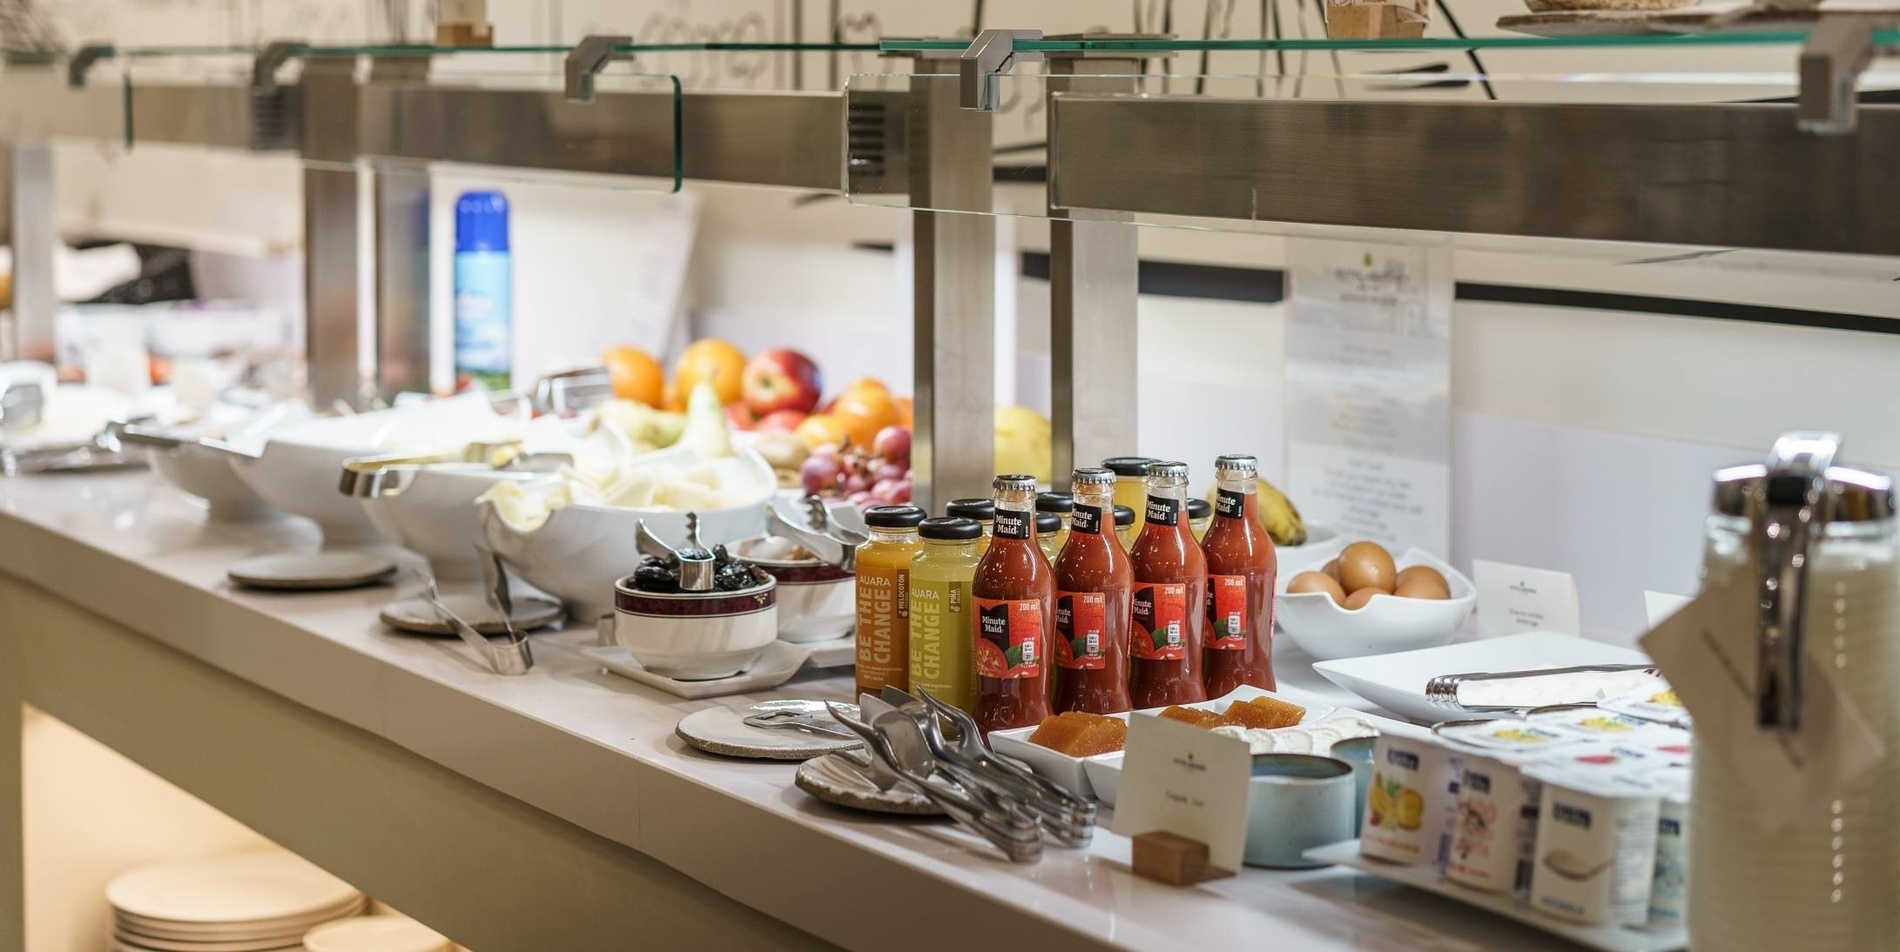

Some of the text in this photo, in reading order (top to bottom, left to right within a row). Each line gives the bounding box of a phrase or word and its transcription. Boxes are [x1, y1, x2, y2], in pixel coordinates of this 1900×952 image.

[1073, 508, 1092, 520] inute
[995, 514, 1022, 526] Minute
[997, 524, 1017, 535] Maid
[859, 575, 891, 587] AUARA
[1224, 578, 1235, 587] 200
[1164, 586, 1175, 595] 200
[1083, 595, 1094, 604] 200
[1019, 602, 1030, 611] 200
[859, 586, 872, 662] BE THE
[982, 615, 1006, 626] Minute
[873, 589, 891, 664] CHANGE
[984, 624, 1003, 634] Maid
[911, 599, 922, 677] BE THE
[923, 602, 940, 680] CHANGE
